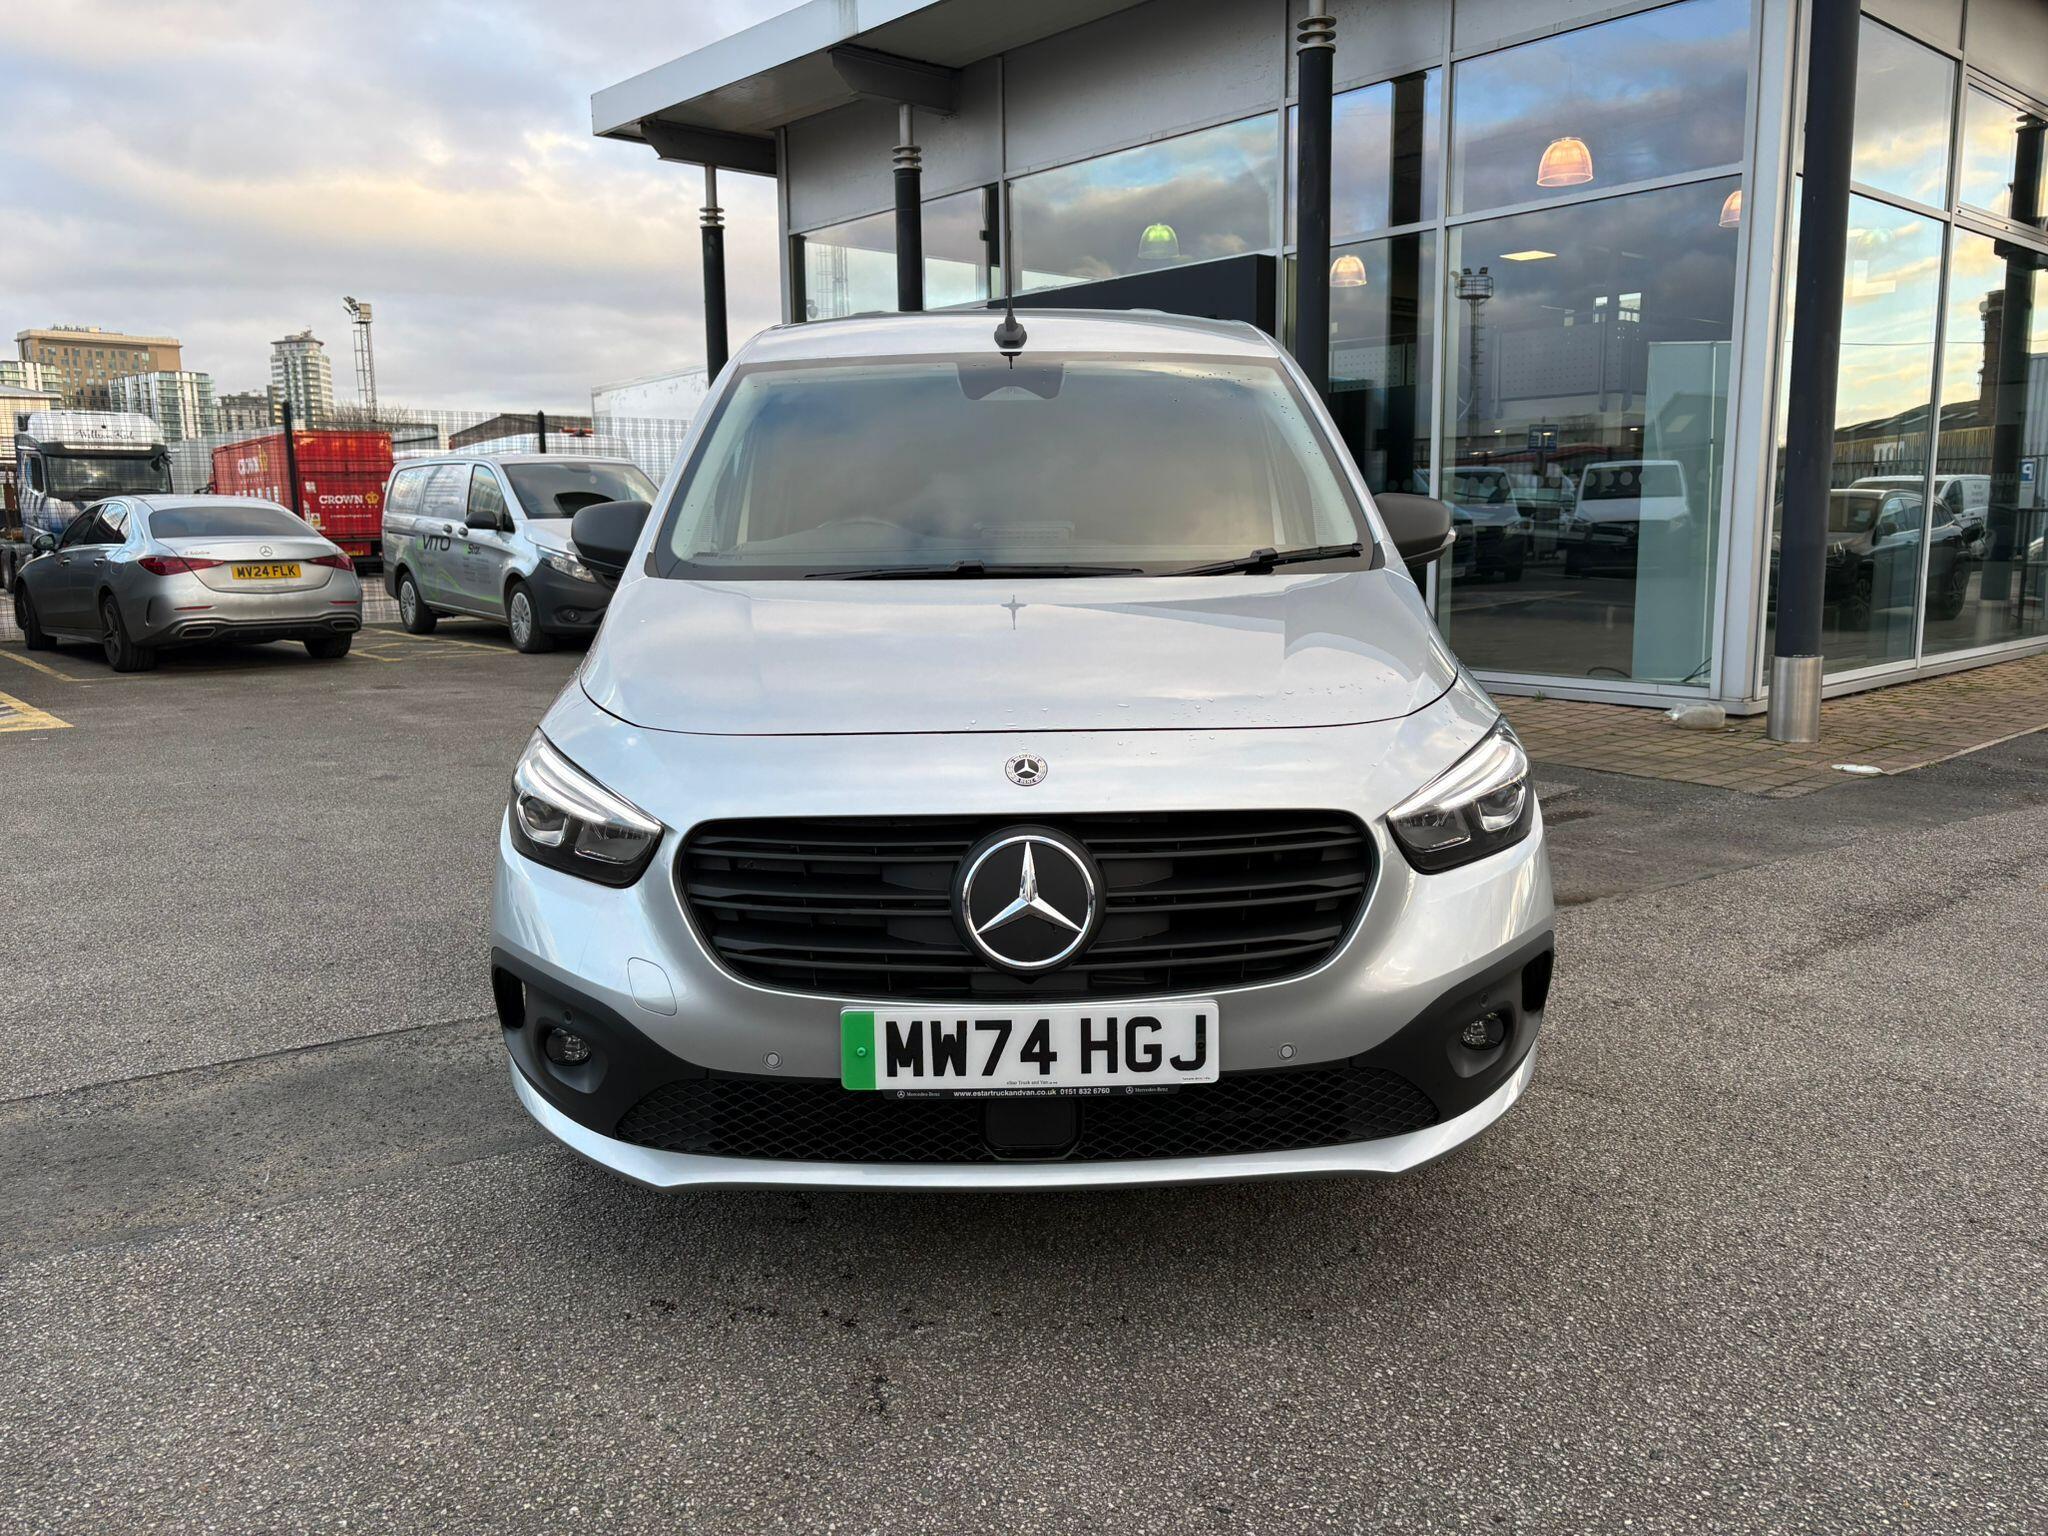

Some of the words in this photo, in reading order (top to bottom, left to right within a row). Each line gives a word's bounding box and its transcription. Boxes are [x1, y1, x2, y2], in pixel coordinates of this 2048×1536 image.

[318, 494, 364, 505] CROWN
[237, 566, 269, 577] MV24
[272, 564, 296, 576] FLK
[885, 1018, 1058, 1078] MW74
[1080, 1014, 1207, 1074] HGJ
[953, 1088, 1057, 1098] www.estartruckandvan.co.uk
